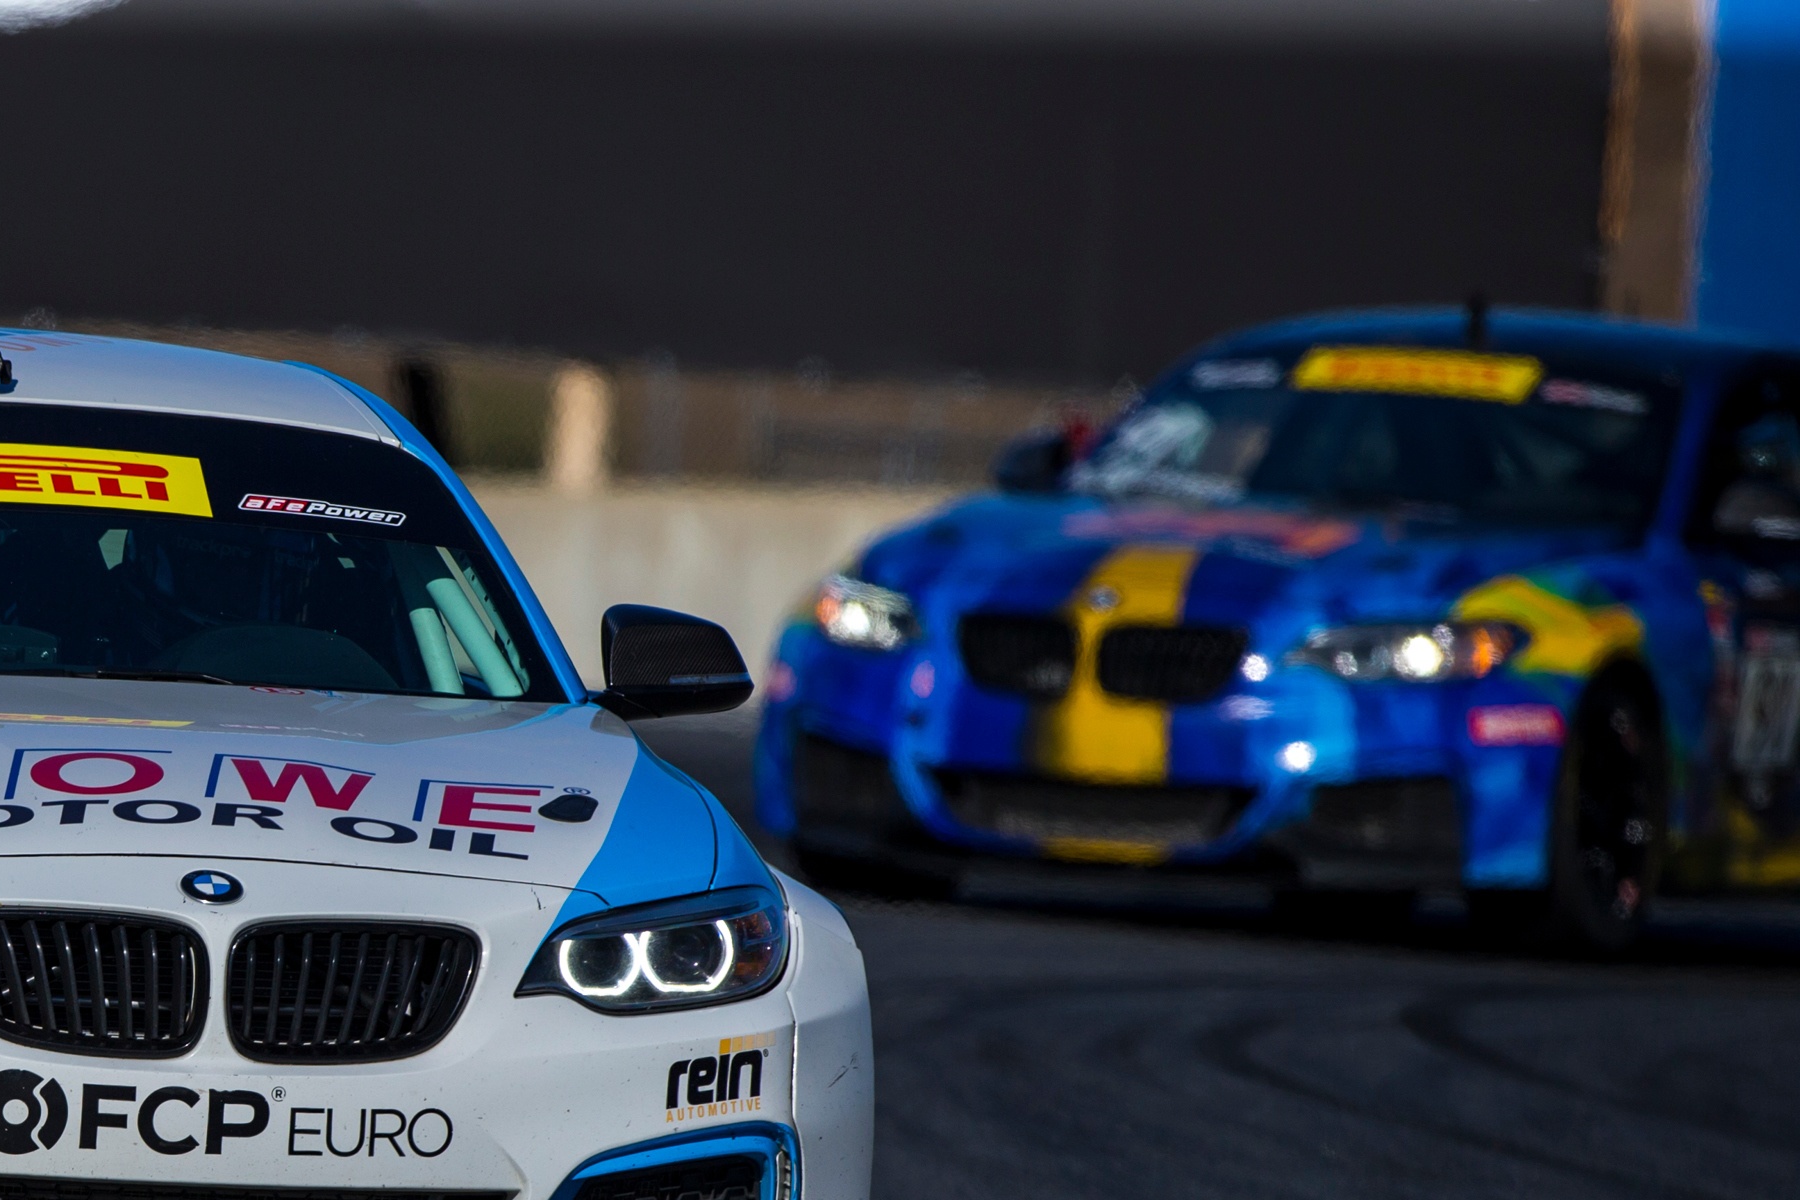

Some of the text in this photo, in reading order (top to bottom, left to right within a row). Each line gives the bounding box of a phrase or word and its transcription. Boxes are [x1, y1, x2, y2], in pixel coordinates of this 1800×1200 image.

[330, 815, 530, 861] OIL
[666, 1038, 763, 1110] rein
[78, 1082, 454, 1158] FCP EURO
[665, 1097, 762, 1124] AUTOMOTIVE
